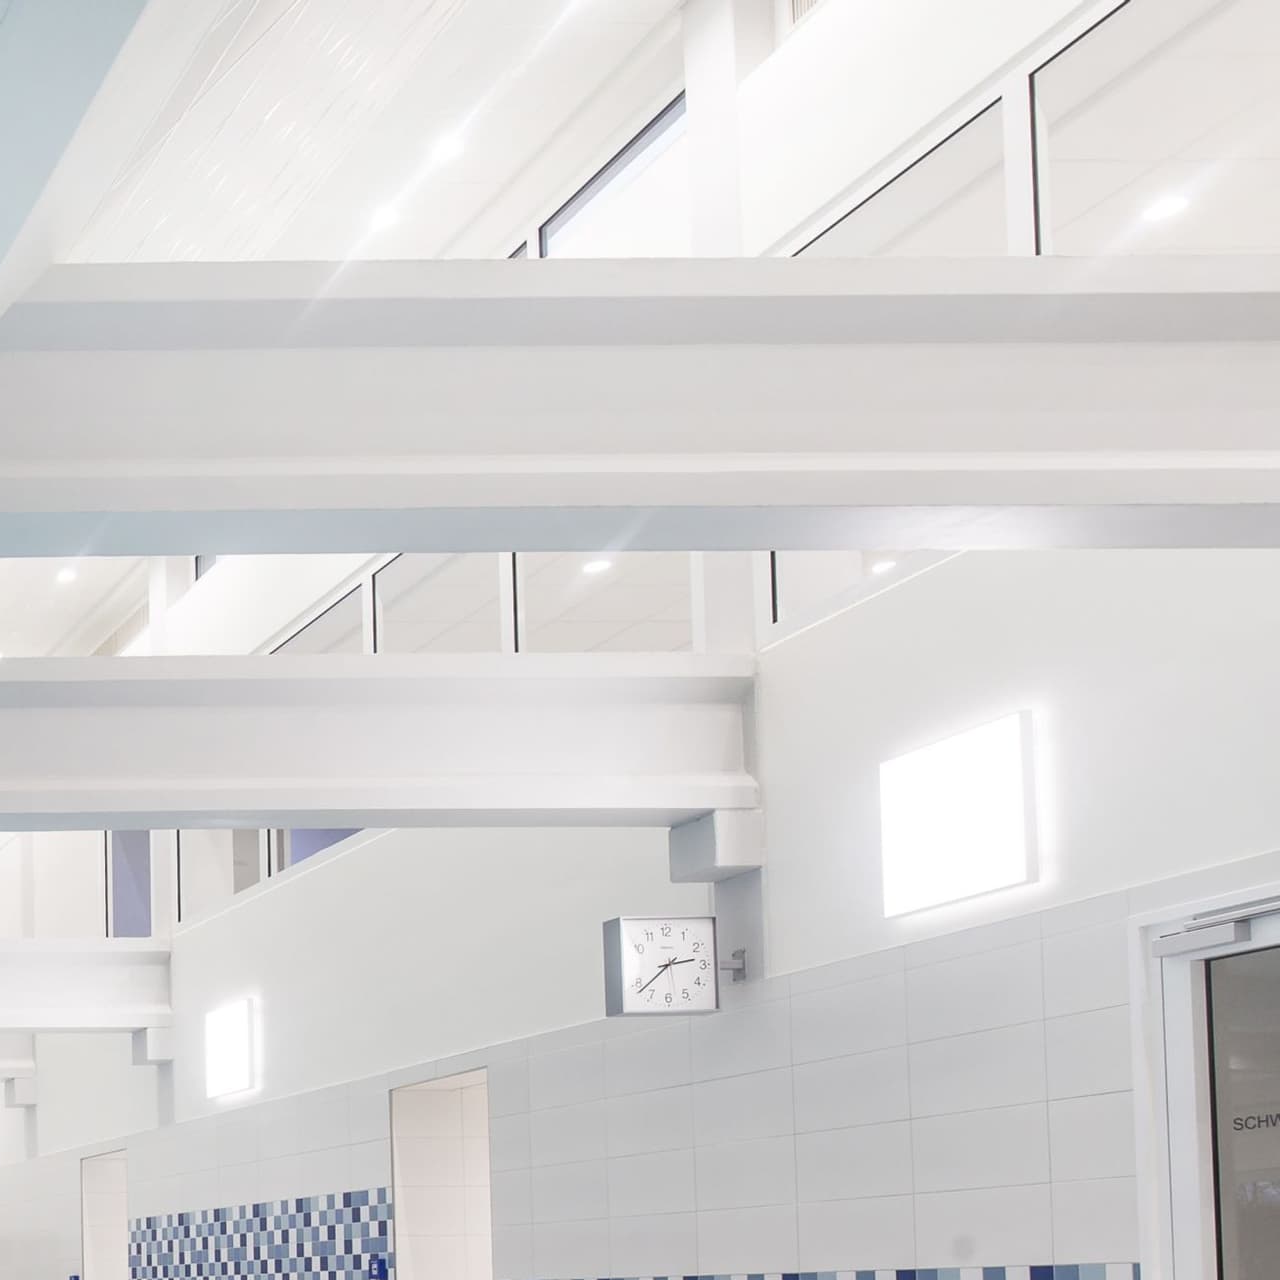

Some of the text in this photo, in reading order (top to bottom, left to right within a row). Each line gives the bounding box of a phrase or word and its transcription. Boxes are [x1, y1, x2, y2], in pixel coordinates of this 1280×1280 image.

[645, 931, 654, 941] 11
[660, 926, 672, 937] 12
[681, 931, 686, 941] 1
[692, 942, 700, 953] 2
[699, 959, 708, 970] 3
[635, 977, 642, 988] 8
[694, 976, 701, 986] 4
[648, 988, 656, 999] 7
[664, 993, 673, 1003] 6
[682, 988, 689, 999] 5
